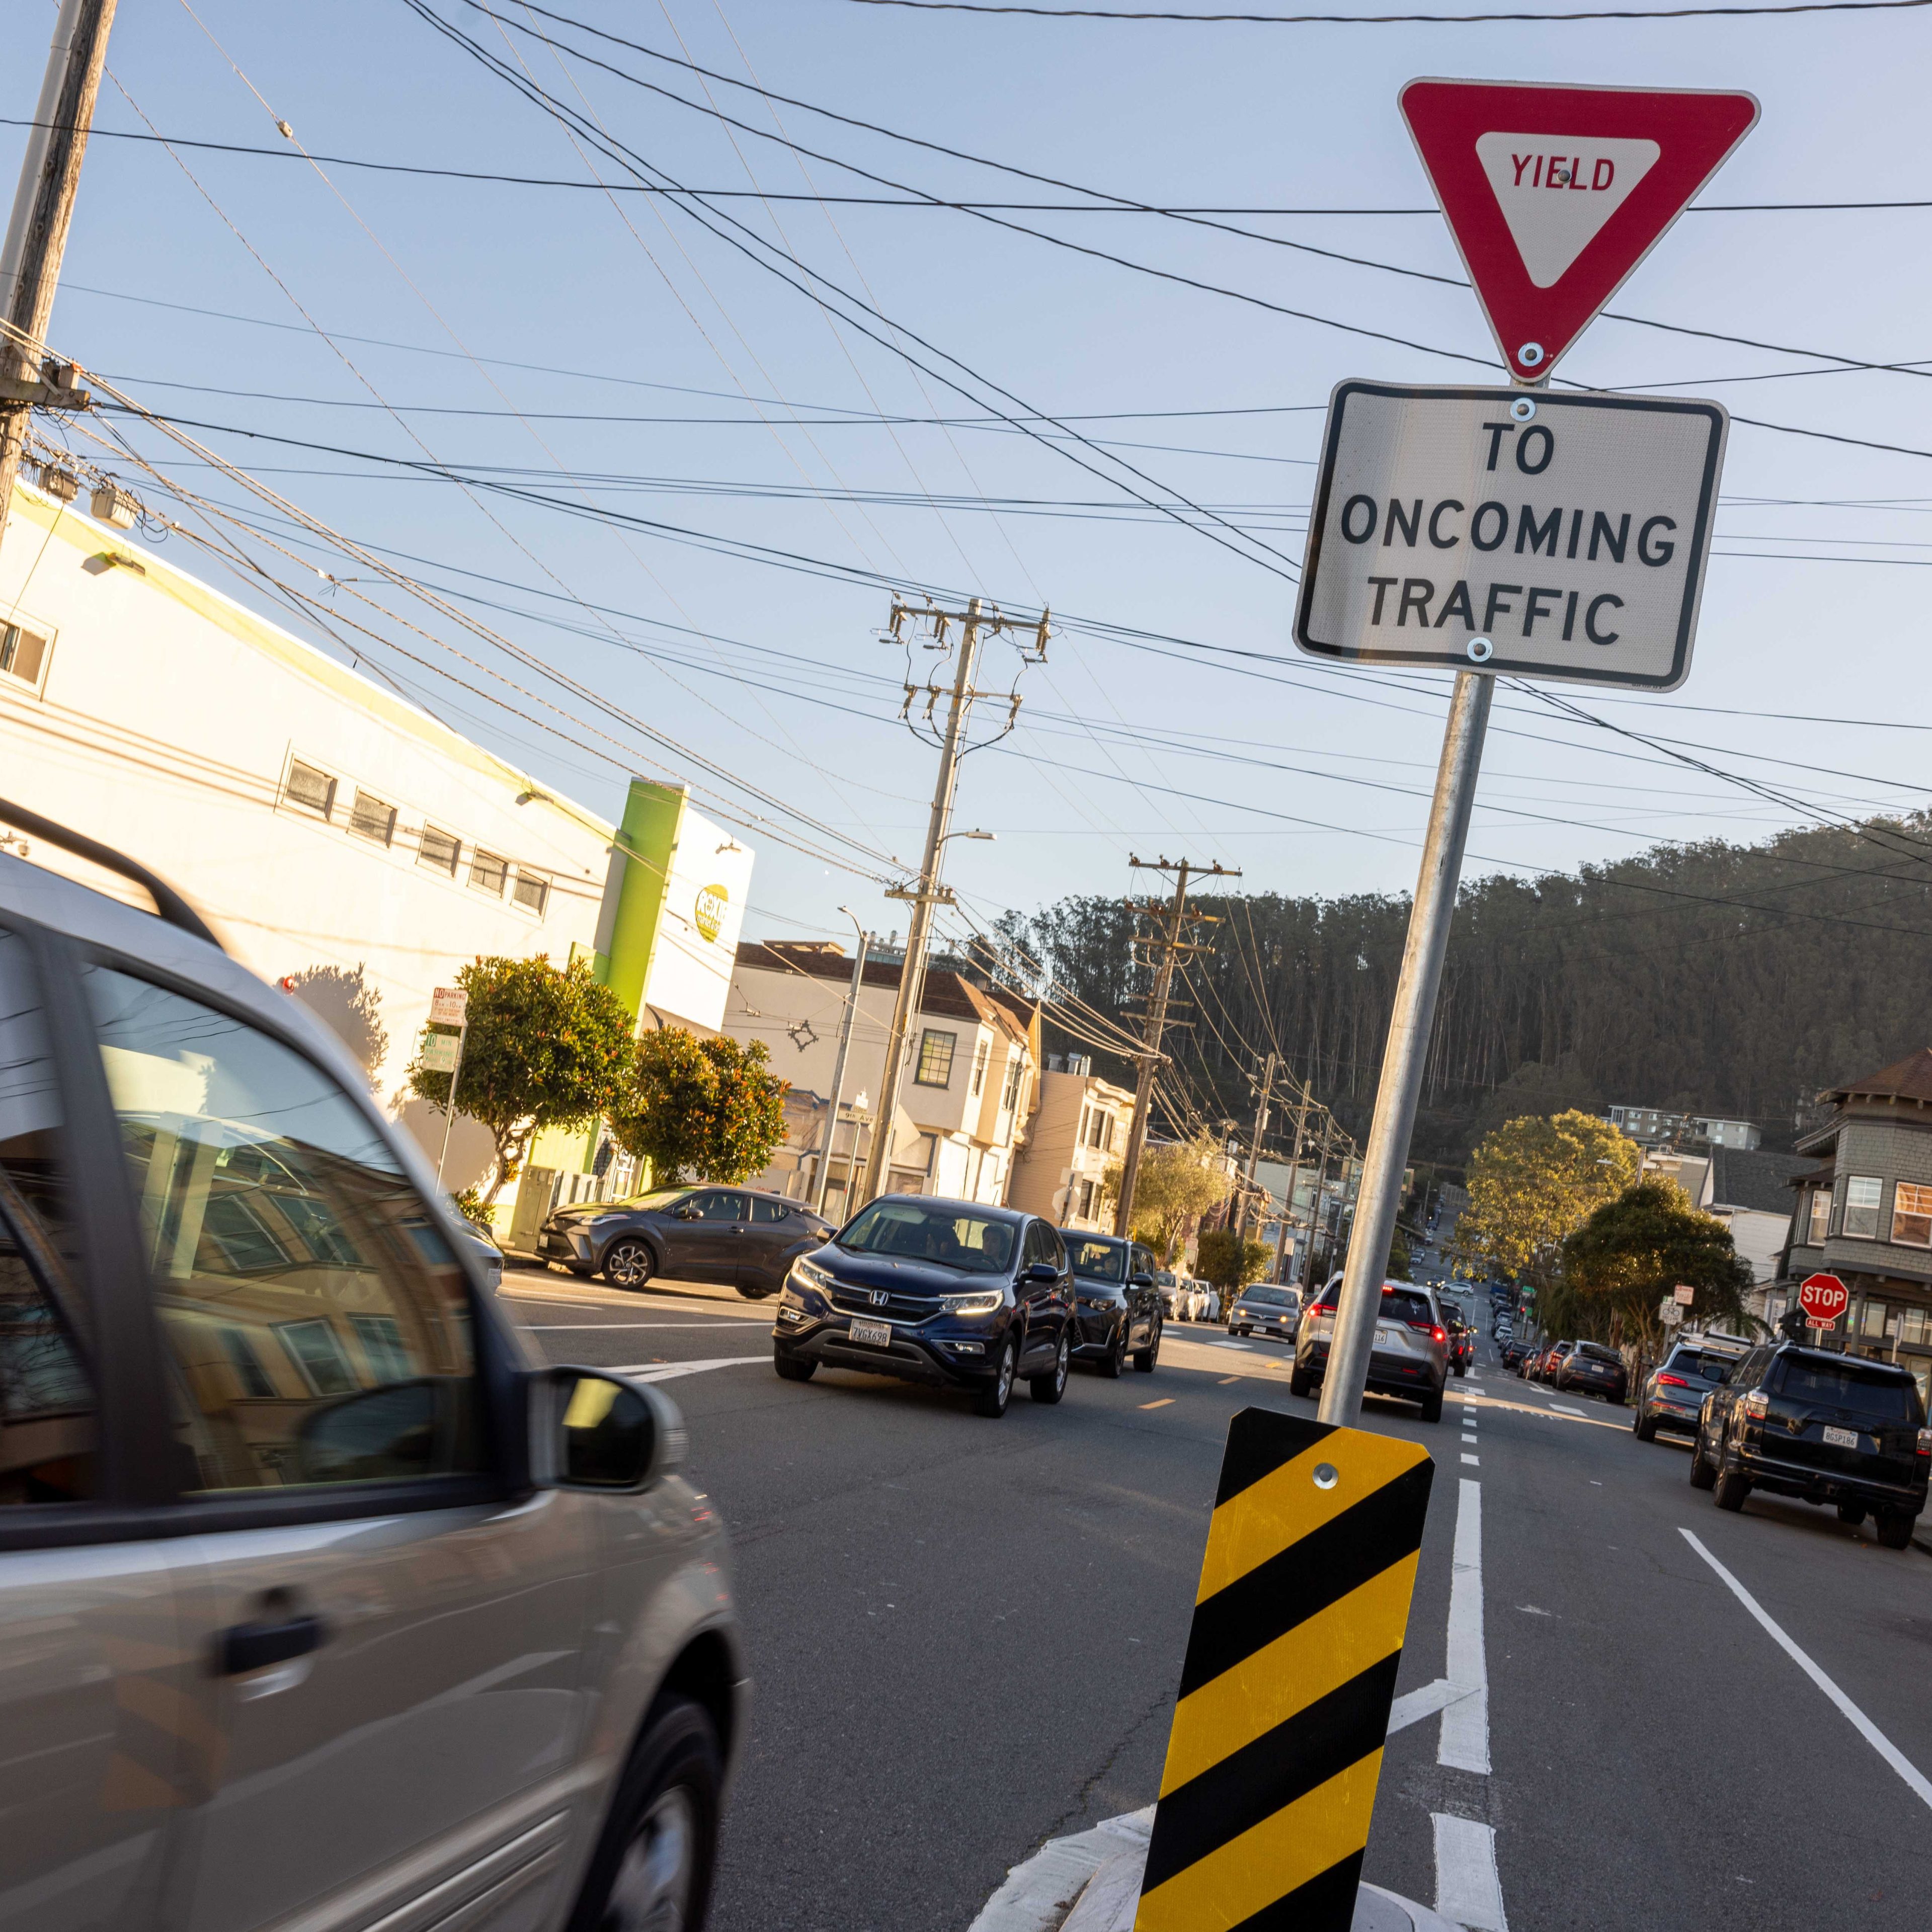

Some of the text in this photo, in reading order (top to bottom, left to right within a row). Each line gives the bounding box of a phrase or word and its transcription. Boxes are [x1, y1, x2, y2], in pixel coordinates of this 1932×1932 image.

[1511, 153, 1615, 191] YIELD
[1482, 422, 1555, 475] TO
[1339, 494, 1677, 568] ONCOMING
[1367, 576, 1625, 646] TRAFFIC
[434, 988, 465, 1000] NO PARKING
[428, 1034, 452, 1046] 10 MIN
[1803, 1285, 1844, 1308] STOP
